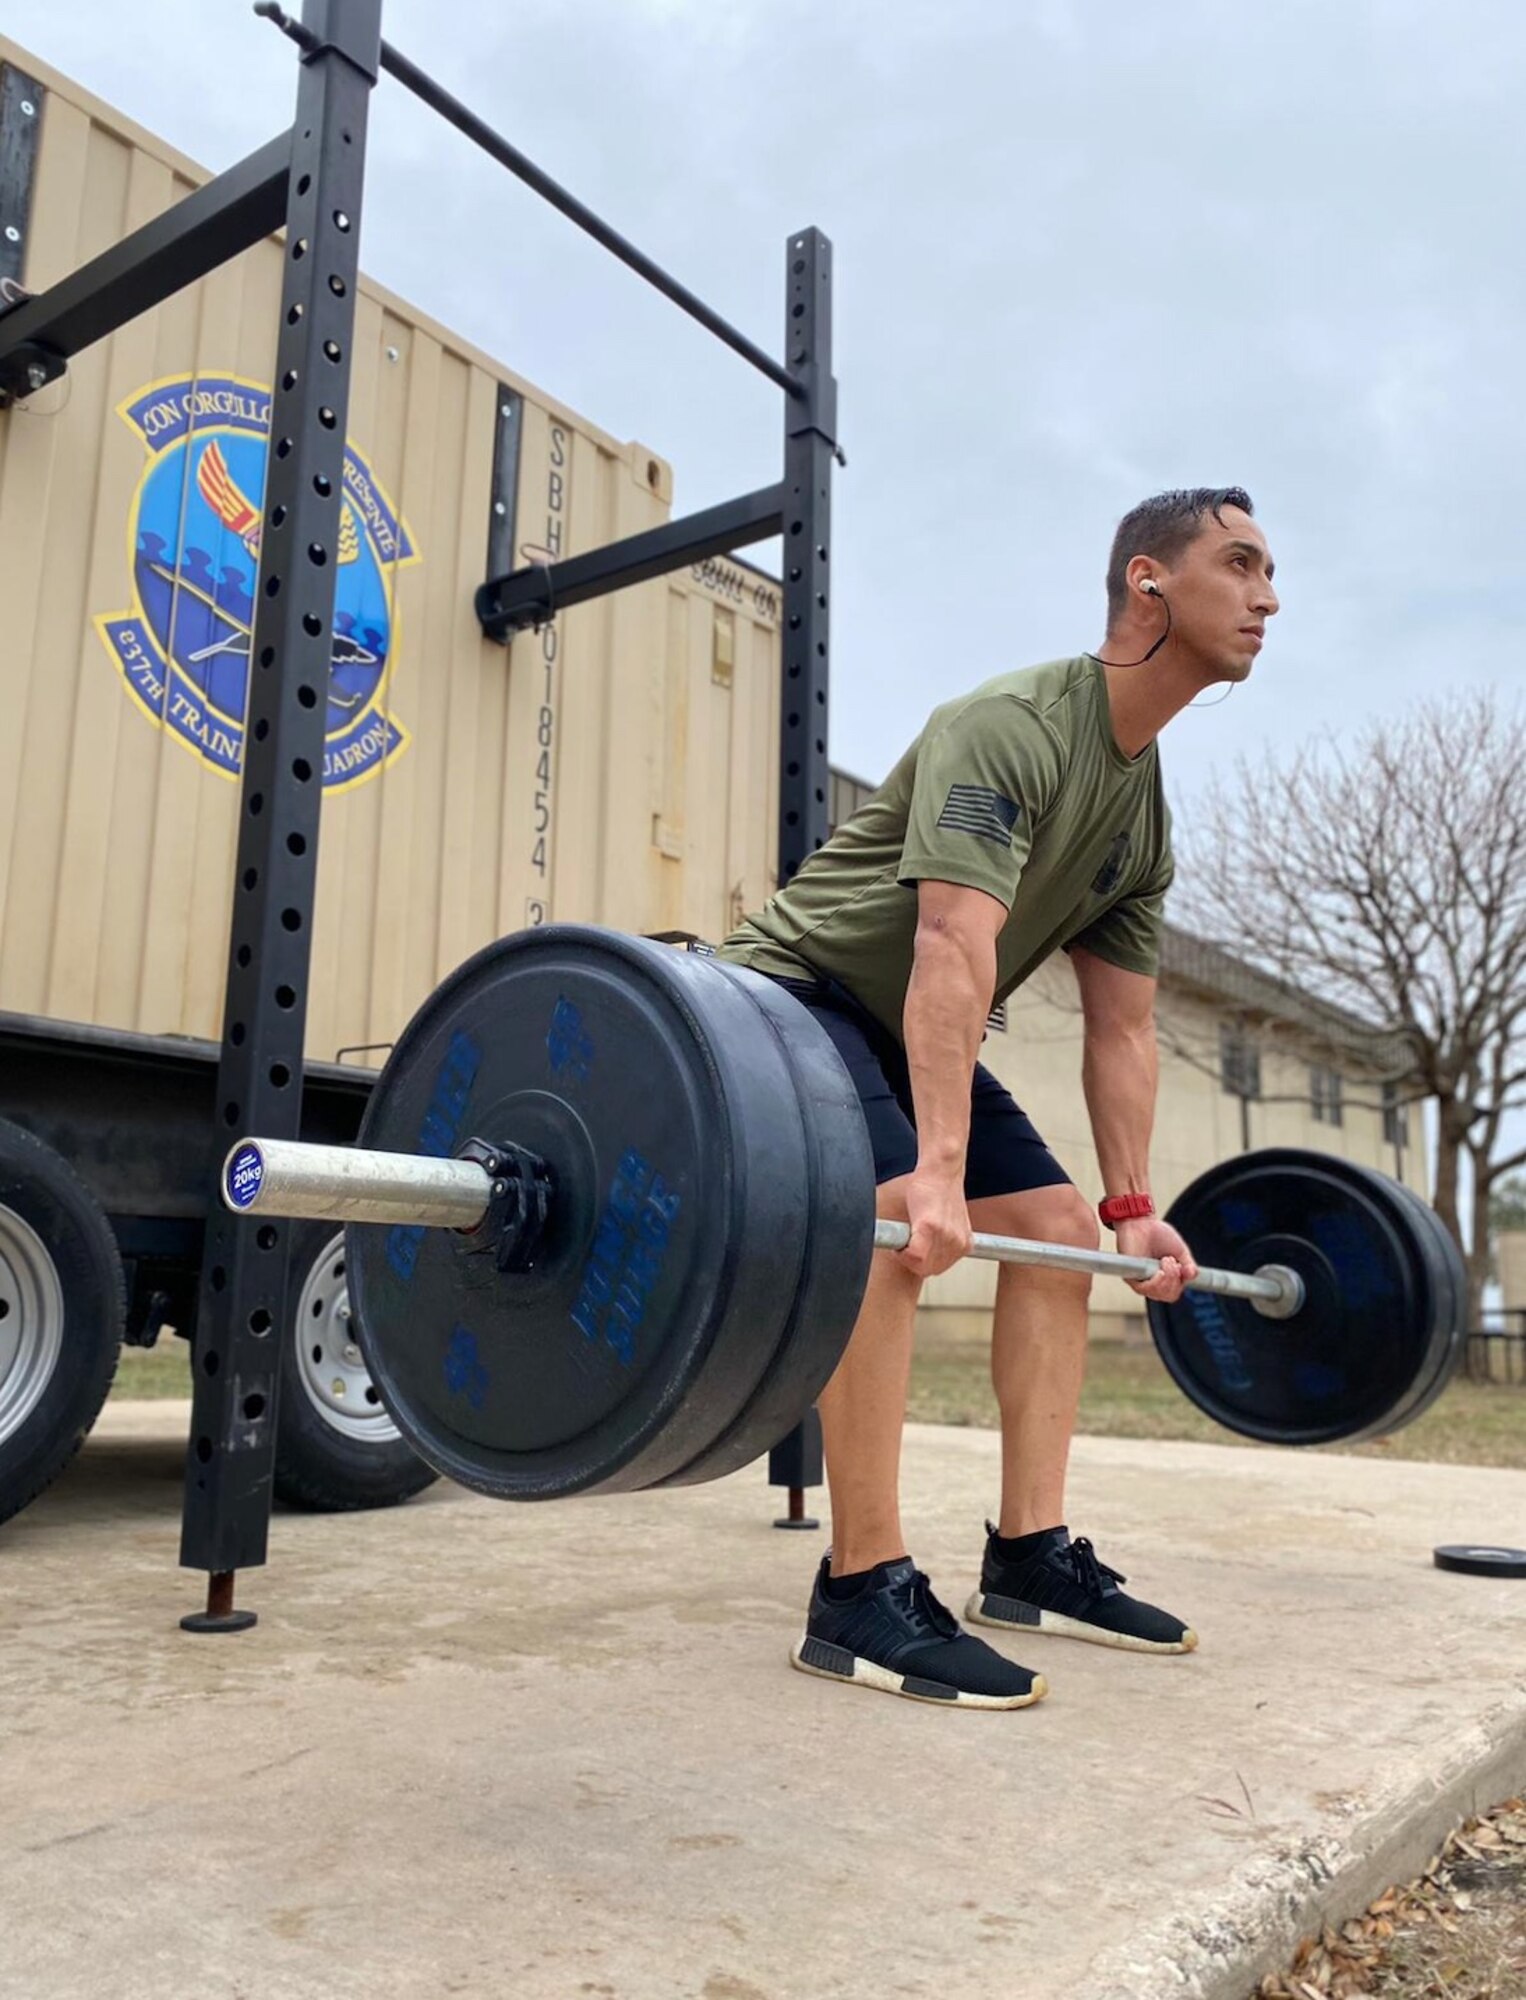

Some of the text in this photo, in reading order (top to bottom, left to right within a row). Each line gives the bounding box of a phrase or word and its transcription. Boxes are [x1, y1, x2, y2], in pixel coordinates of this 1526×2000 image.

[143, 398, 182, 435] CON
[547, 428, 564, 557] SBH
[119, 629, 164, 700] 837TH
[170, 692, 243, 763] TRAIN
[532, 622, 558, 878] 018454
[233, 1166, 262, 1189] 20kg
